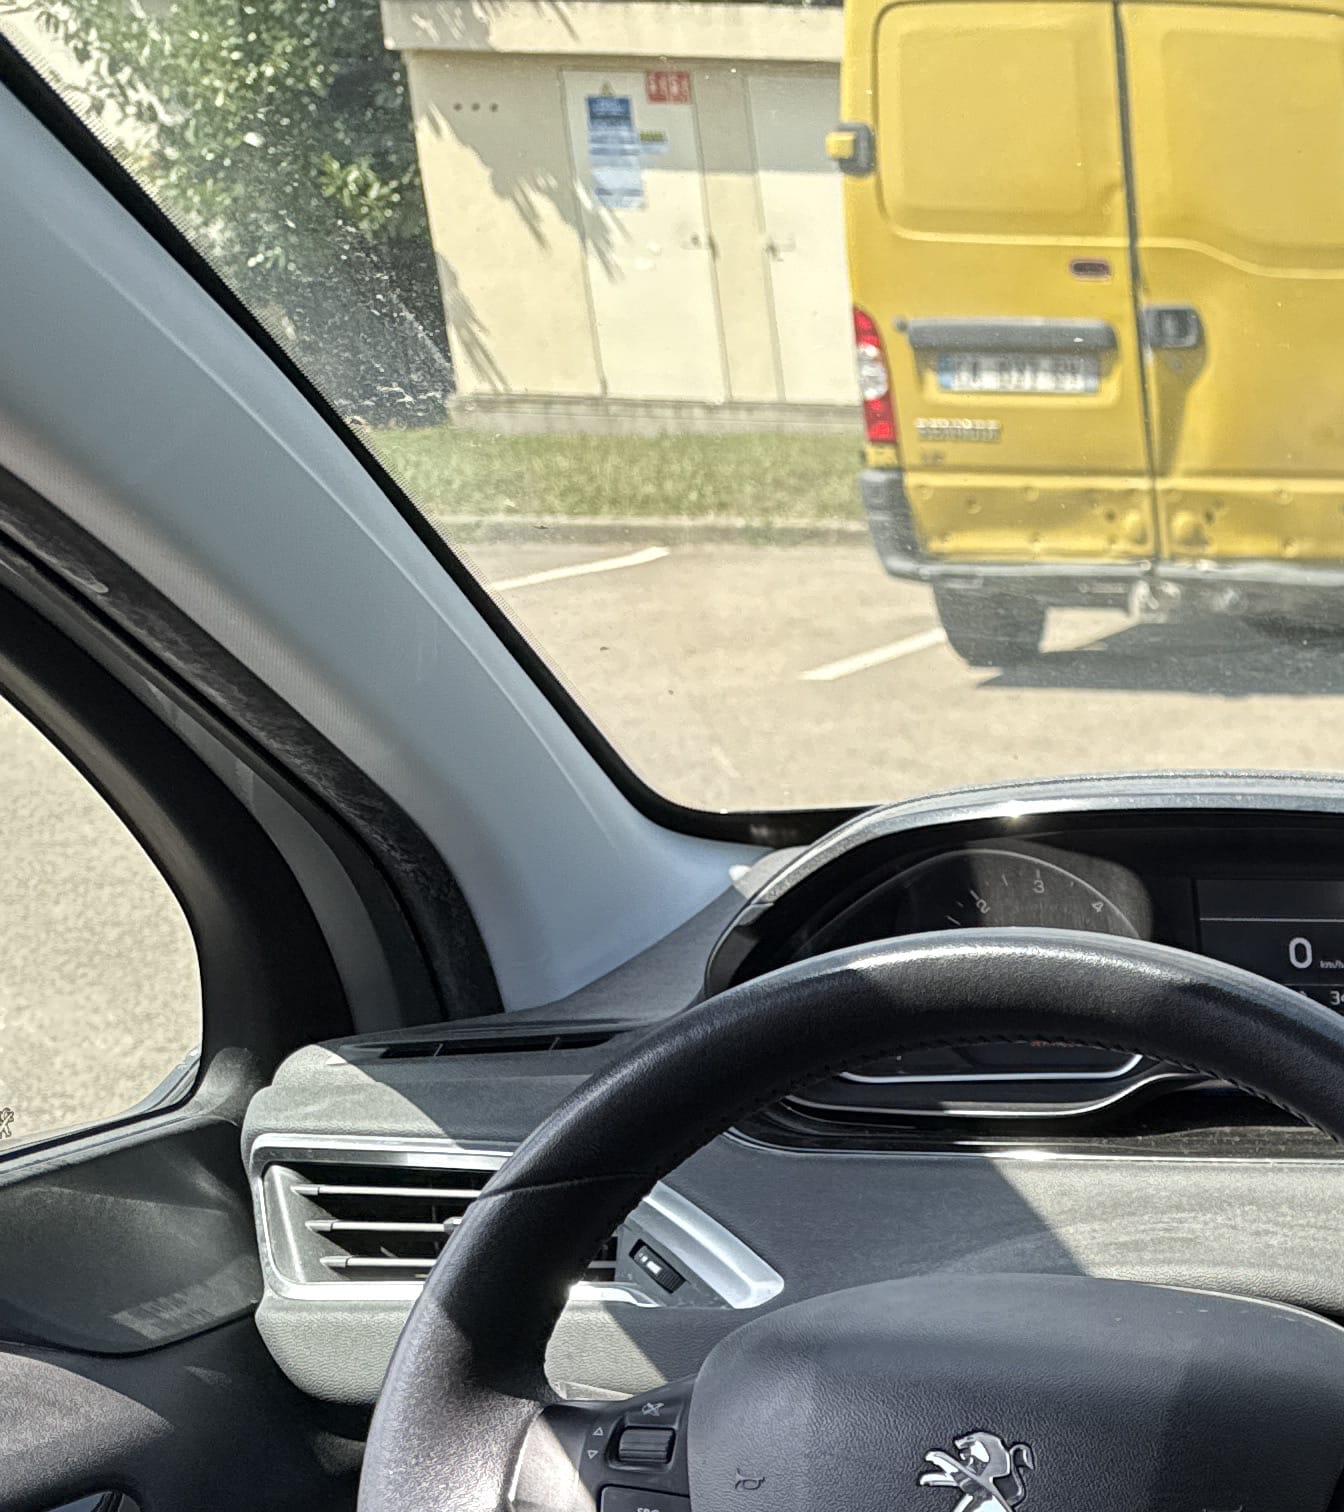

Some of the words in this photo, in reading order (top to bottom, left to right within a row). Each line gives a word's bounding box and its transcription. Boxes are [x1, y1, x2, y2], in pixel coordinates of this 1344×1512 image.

[1032, 879, 1045, 894] 3
[975, 899, 991, 915] 2
[1090, 901, 1105, 913] 4
[1288, 936, 1313, 969] 0
